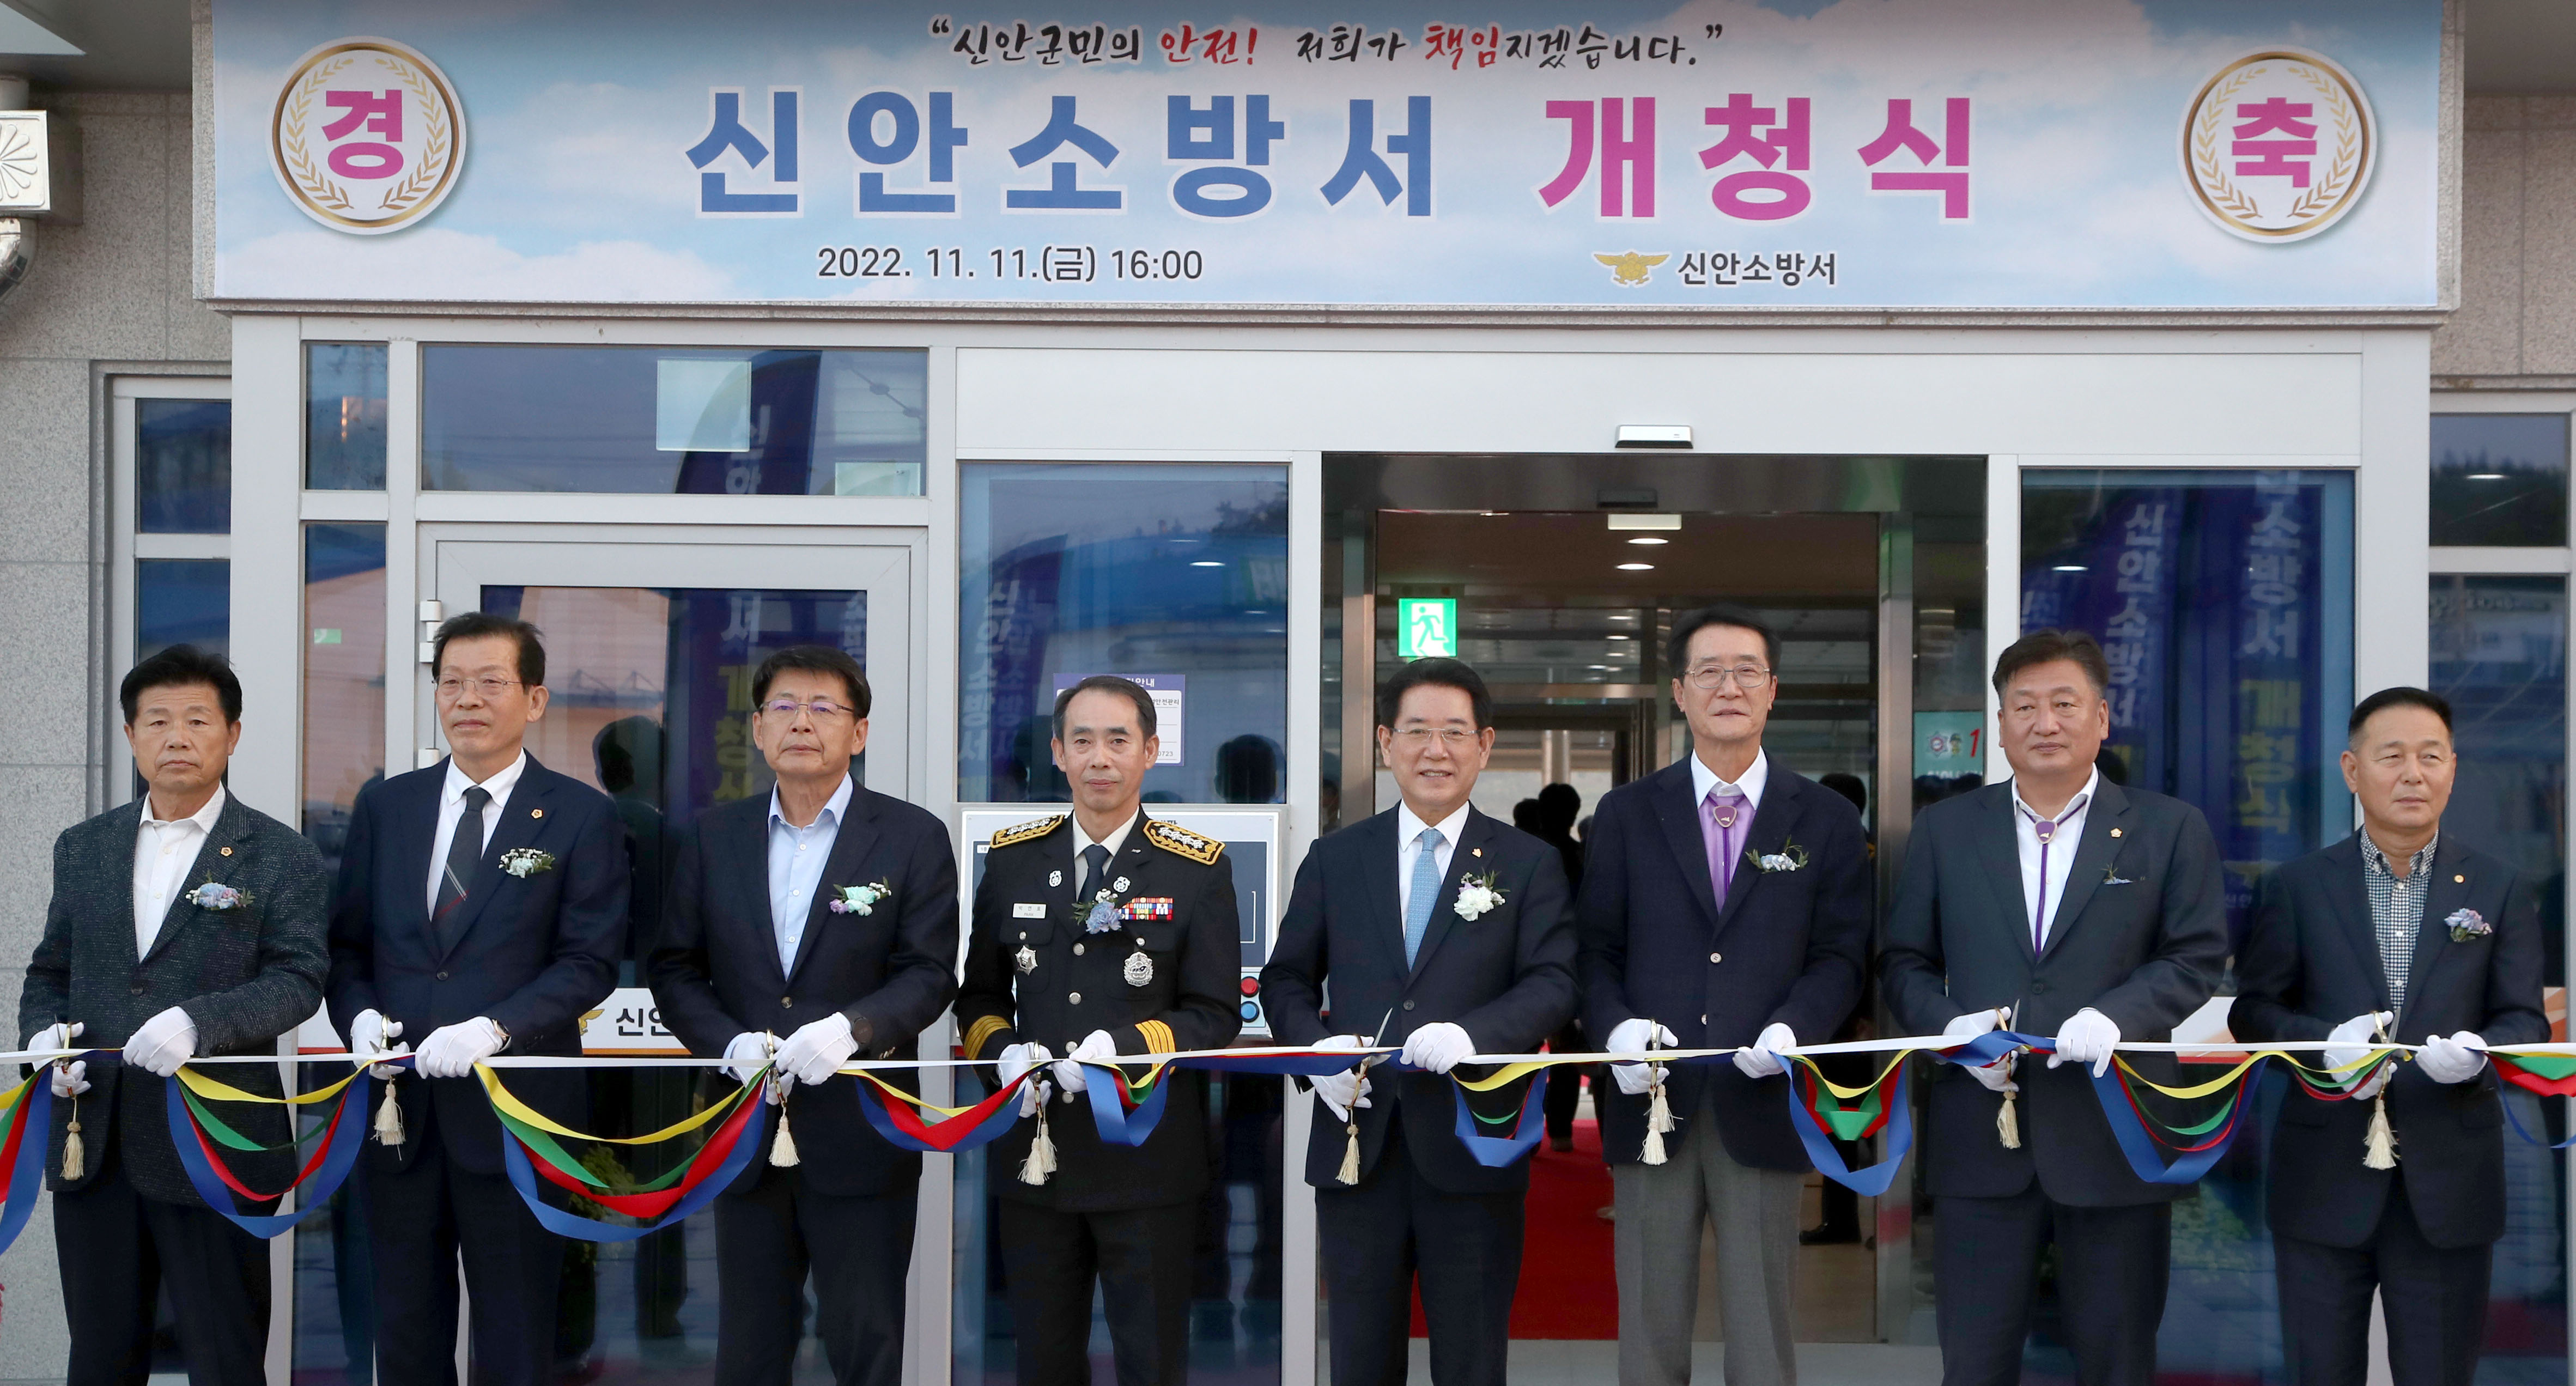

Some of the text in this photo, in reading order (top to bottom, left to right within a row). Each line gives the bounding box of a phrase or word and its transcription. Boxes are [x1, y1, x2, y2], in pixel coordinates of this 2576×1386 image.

[1161, 24, 1259, 65] 안전!
[1296, 25, 1407, 63] 저희가
[321, 89, 404, 180] 경
[2231, 96, 2318, 189] 축
[818, 245, 1203, 282] 2022. 11. 11.(금) 16:00
[1678, 252, 1836, 287] 신안소방서
